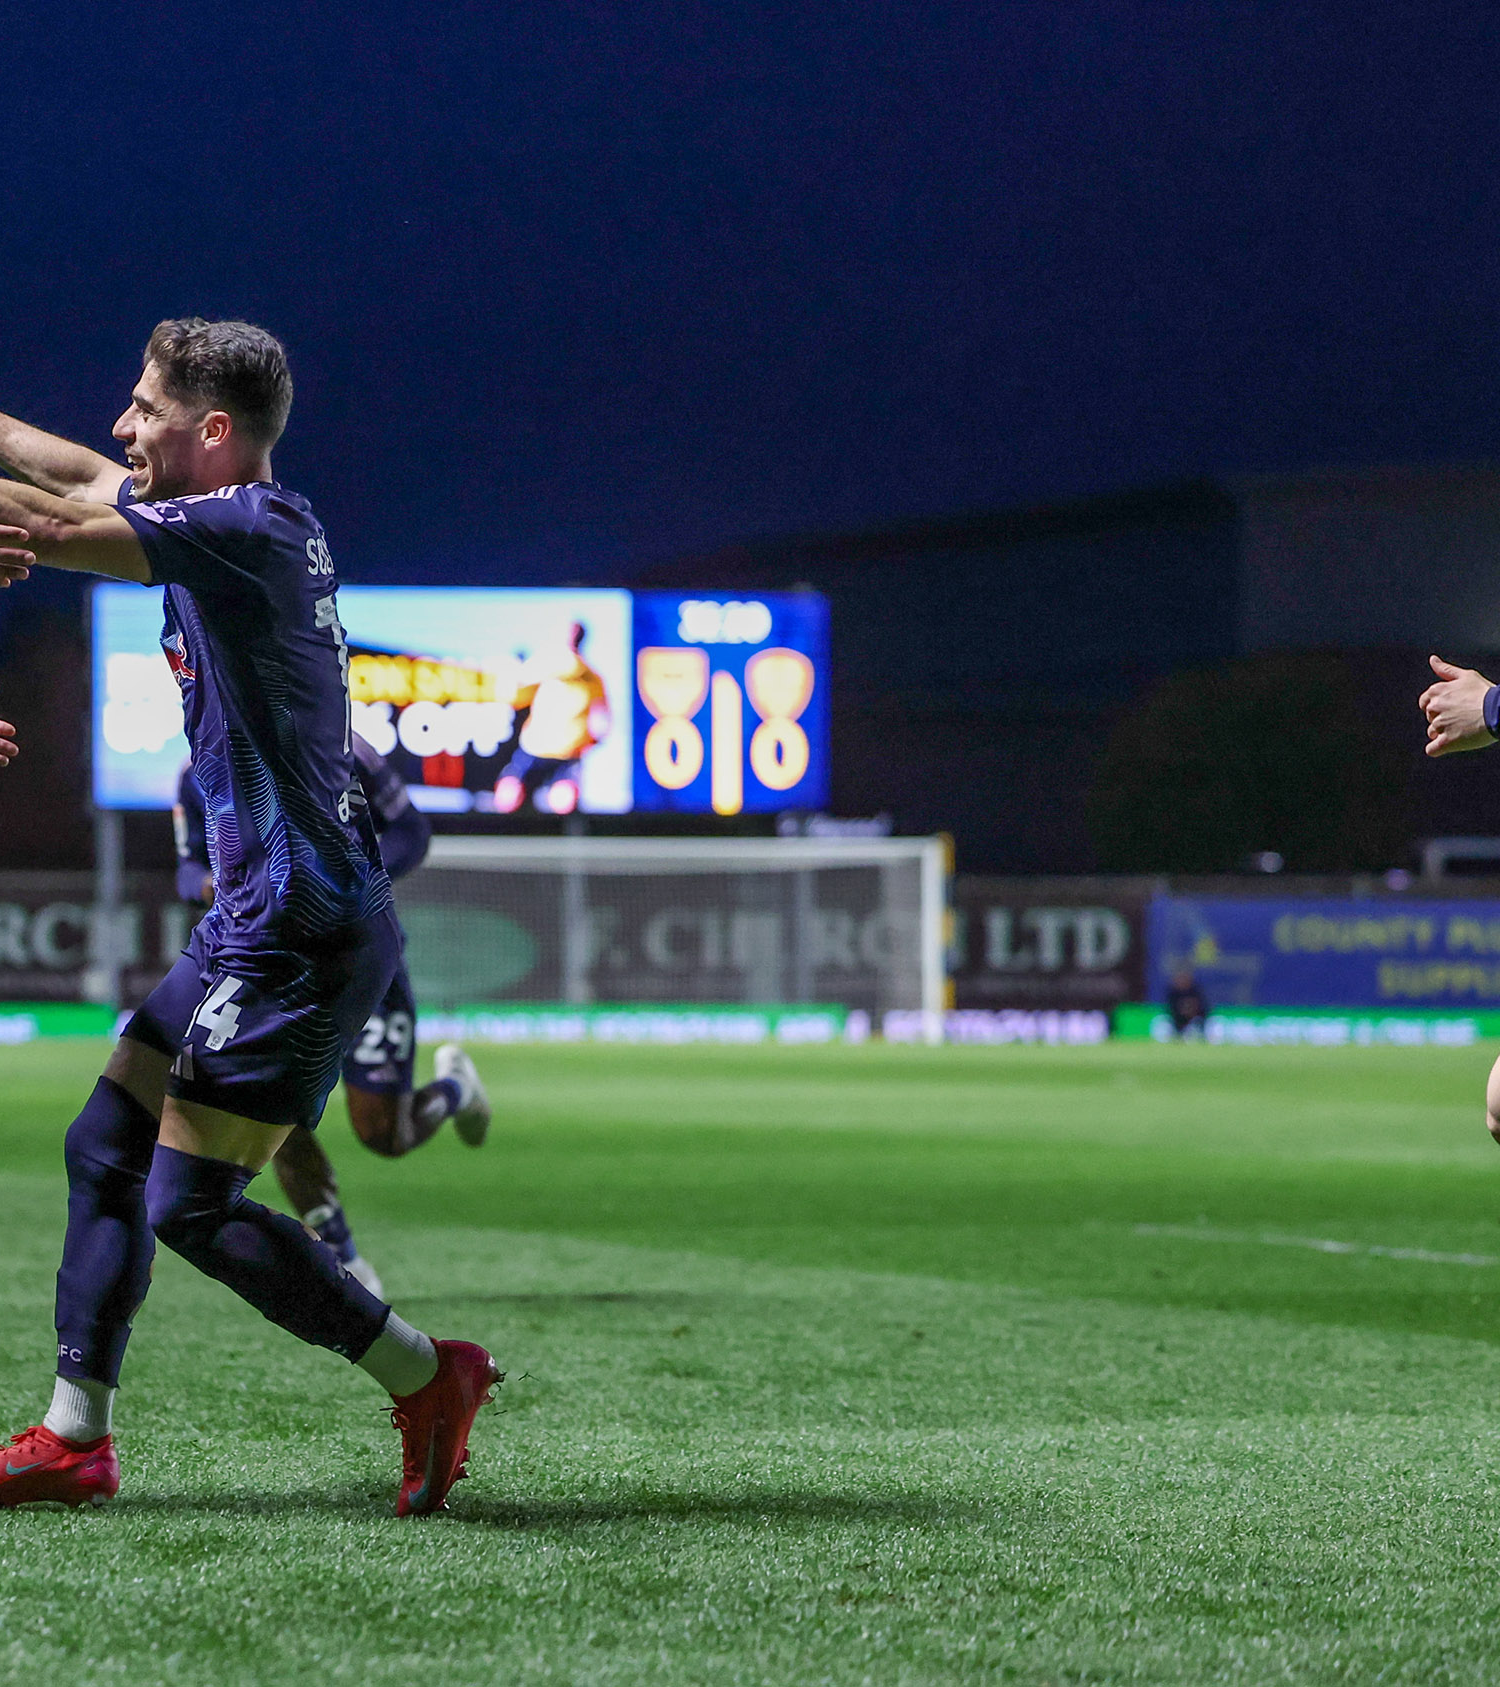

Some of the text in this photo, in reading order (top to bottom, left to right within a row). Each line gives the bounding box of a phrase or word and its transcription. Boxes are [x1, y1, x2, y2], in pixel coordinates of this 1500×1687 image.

[644, 714, 810, 791] 0 0
[983, 907, 1132, 971] LTD
[354, 1011, 413, 1065] 29
